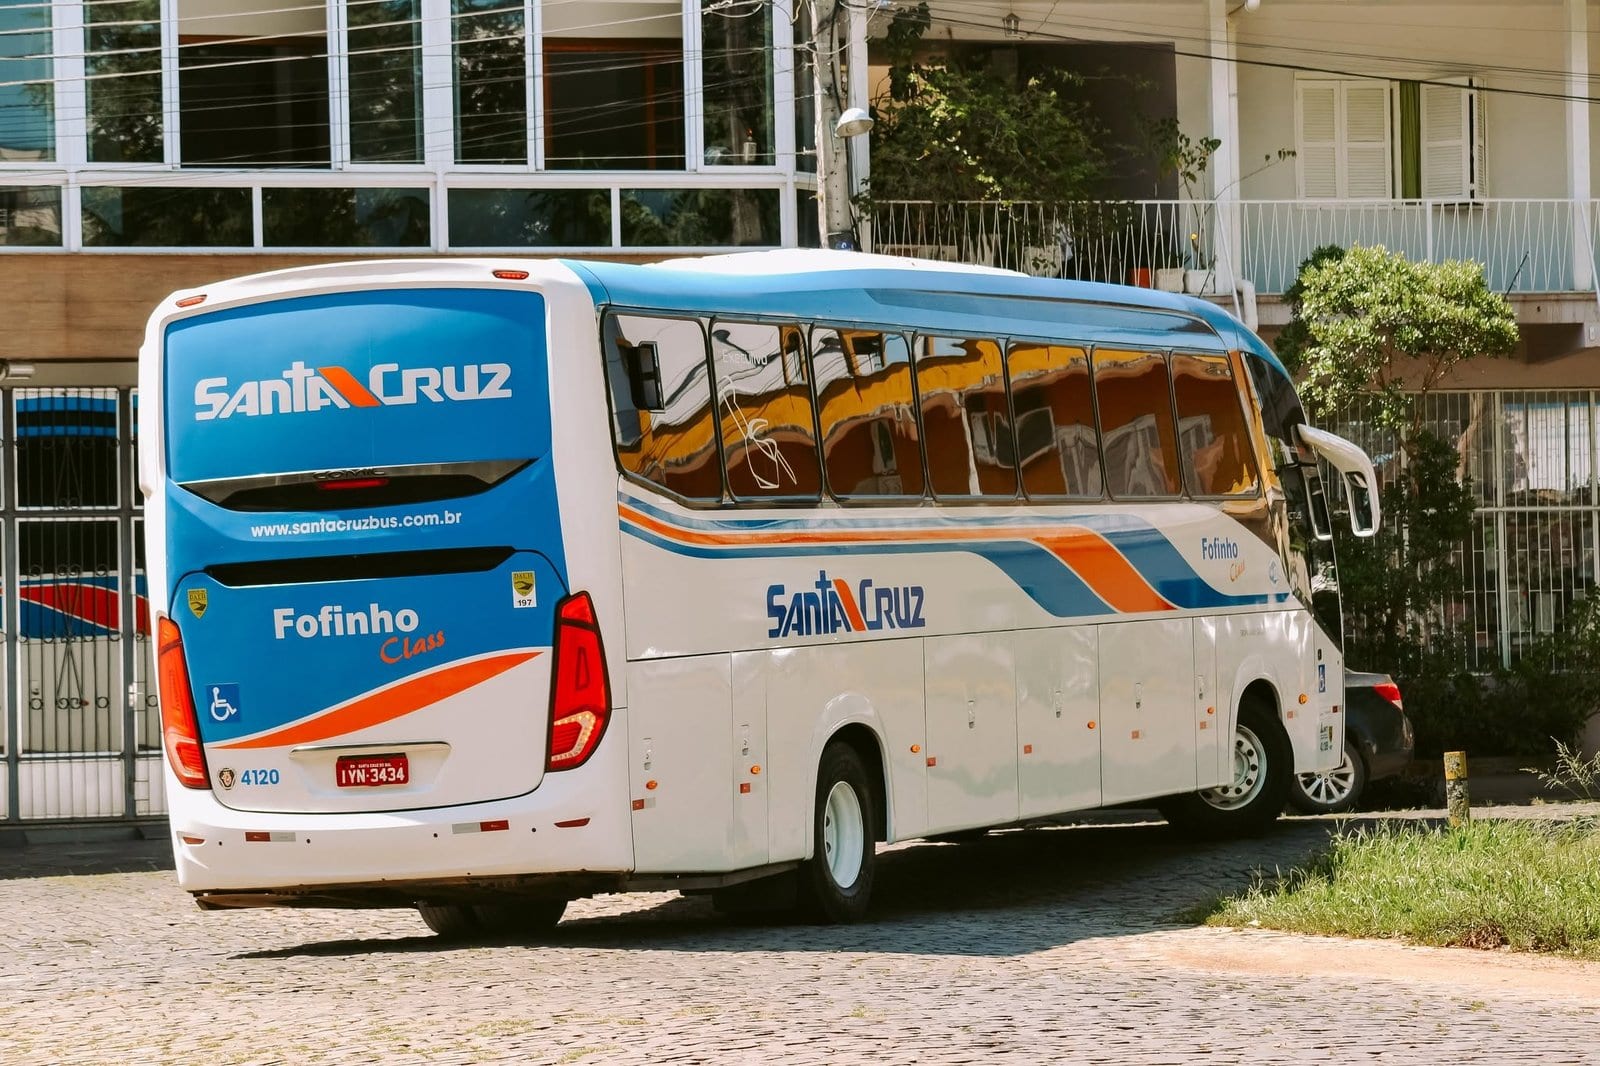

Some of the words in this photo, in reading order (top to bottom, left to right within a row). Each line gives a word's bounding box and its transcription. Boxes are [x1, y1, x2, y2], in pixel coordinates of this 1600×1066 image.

[368, 362, 513, 407] CRUZ
[251, 510, 462, 537] www.santacruzbus.com.br
[1201, 537, 1239, 560] Fofinho
[517, 599, 532, 607] 197
[859, 578, 926, 631] CRUZ
[273, 603, 419, 640] Fofinho
[380, 630, 446, 664] Class
[241, 769, 280, 785] 4120
